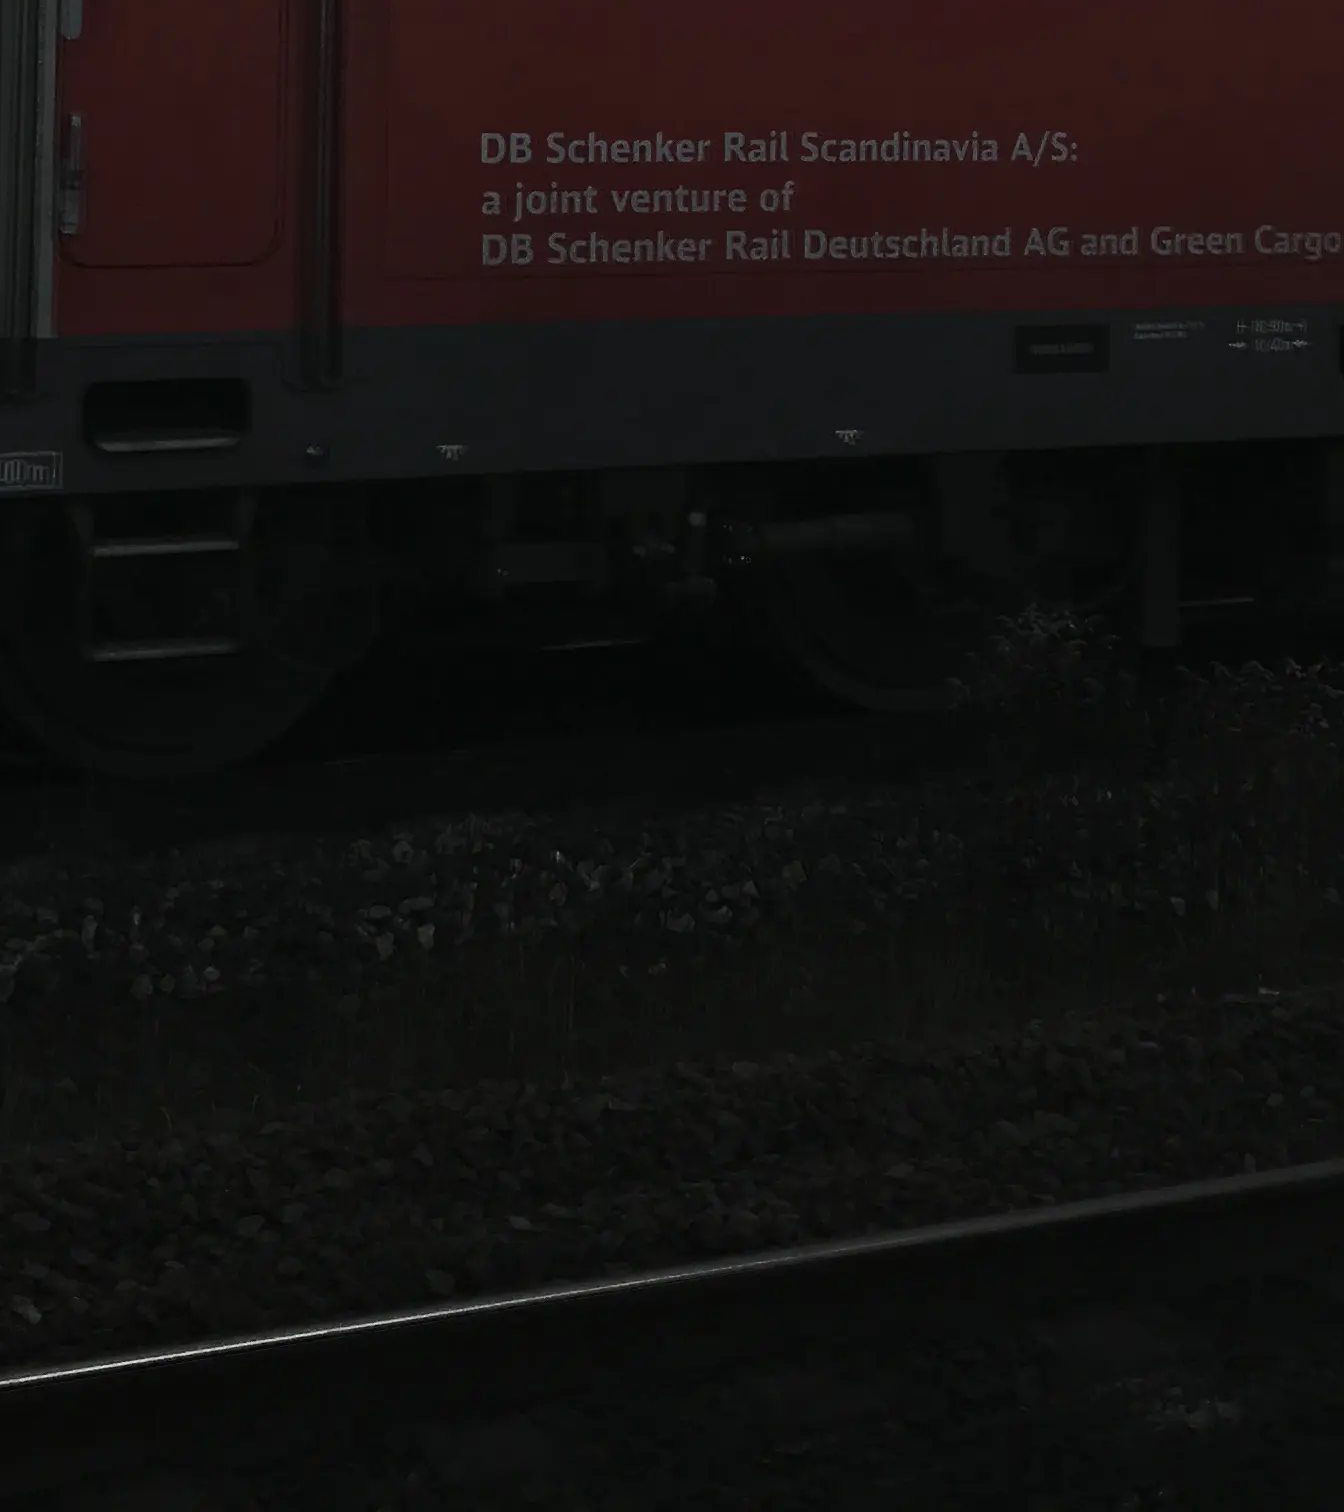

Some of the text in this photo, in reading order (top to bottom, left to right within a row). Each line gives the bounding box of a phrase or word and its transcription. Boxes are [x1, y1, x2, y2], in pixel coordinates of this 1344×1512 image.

[479, 130, 1079, 168] DB Schenker Rail Scandinavia A/S:
[480, 180, 796, 223] a joint venture of
[480, 233, 535, 267] DB
[546, 231, 713, 265] Schenker
[725, 229, 792, 262] Rail
[803, 226, 1012, 261] Deutschland
[1022, 225, 1070, 258] AG
[1079, 225, 1140, 257] and
[1149, 225, 1245, 256] Green
[1253, 224, 1343, 261] Cargo
